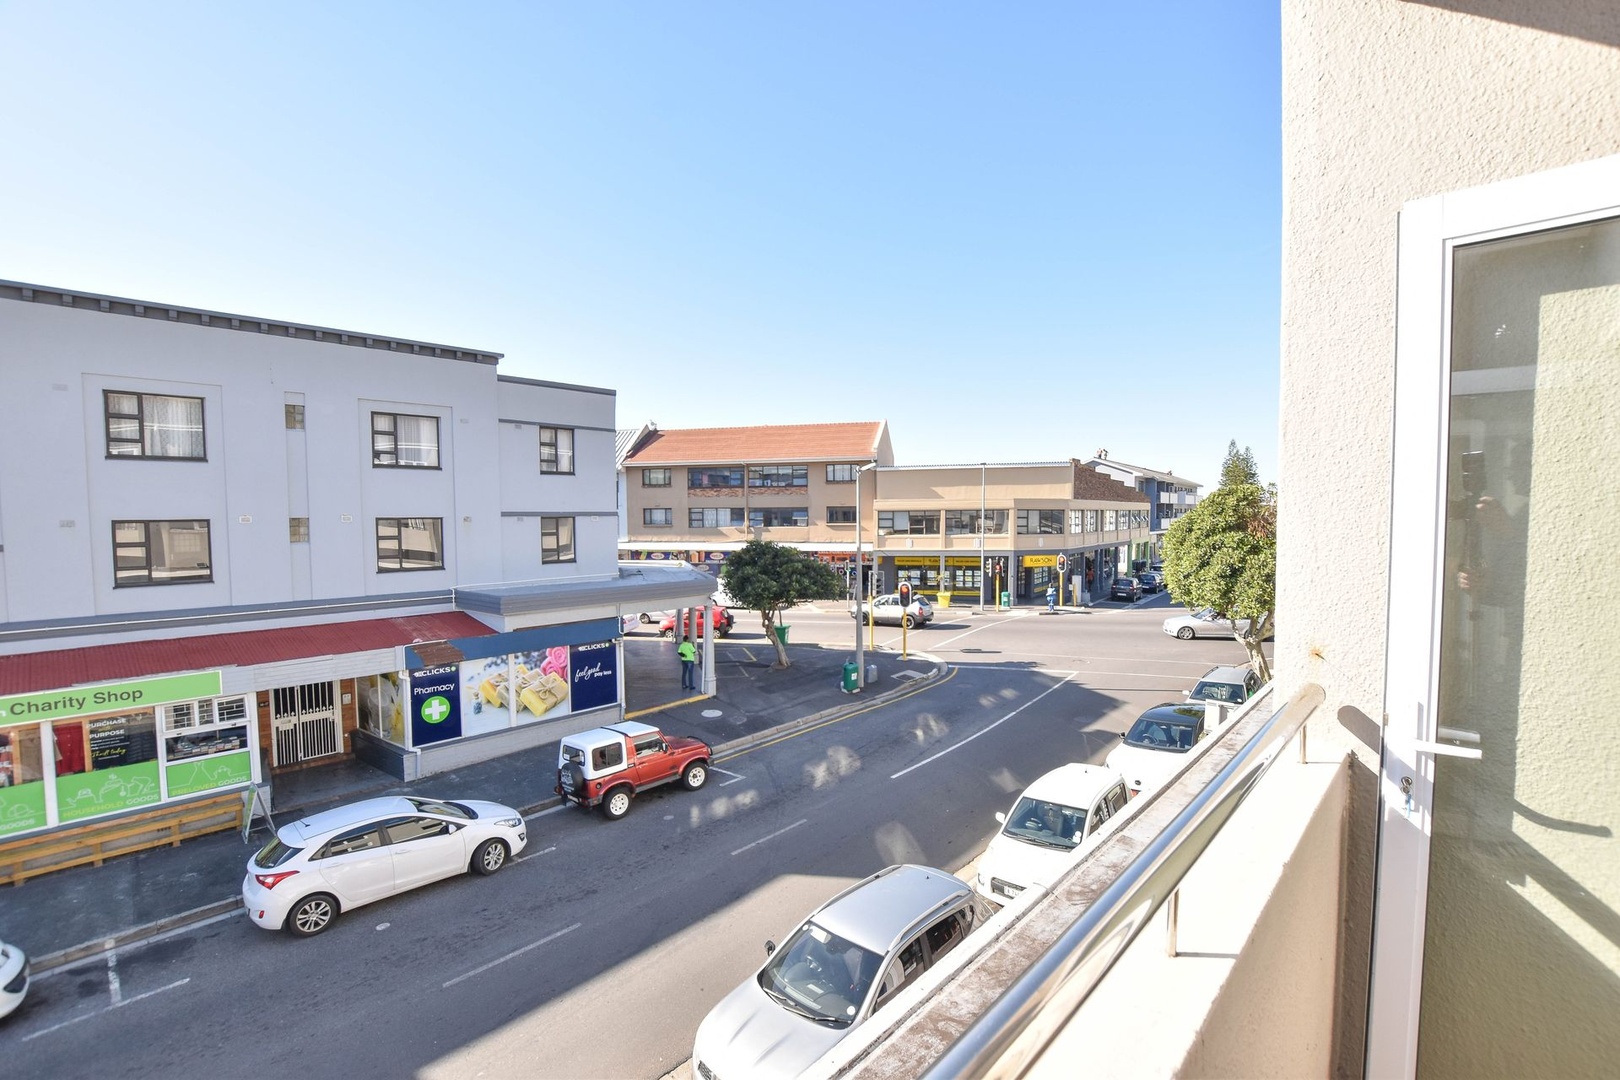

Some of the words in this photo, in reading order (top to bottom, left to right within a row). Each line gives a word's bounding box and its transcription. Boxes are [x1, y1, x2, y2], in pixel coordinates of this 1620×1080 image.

[420, 666, 451, 677] CLICKS
[413, 683, 455, 696] Pharmacy
[9, 696, 87, 716] Charity
[93, 689, 143, 705] Shop
[87, 717, 127, 729] PURCHASE
[89, 728, 125, 739] PURPOSE
[217, 775, 248, 787] GOODS
[126, 794, 159, 805] GOODS
